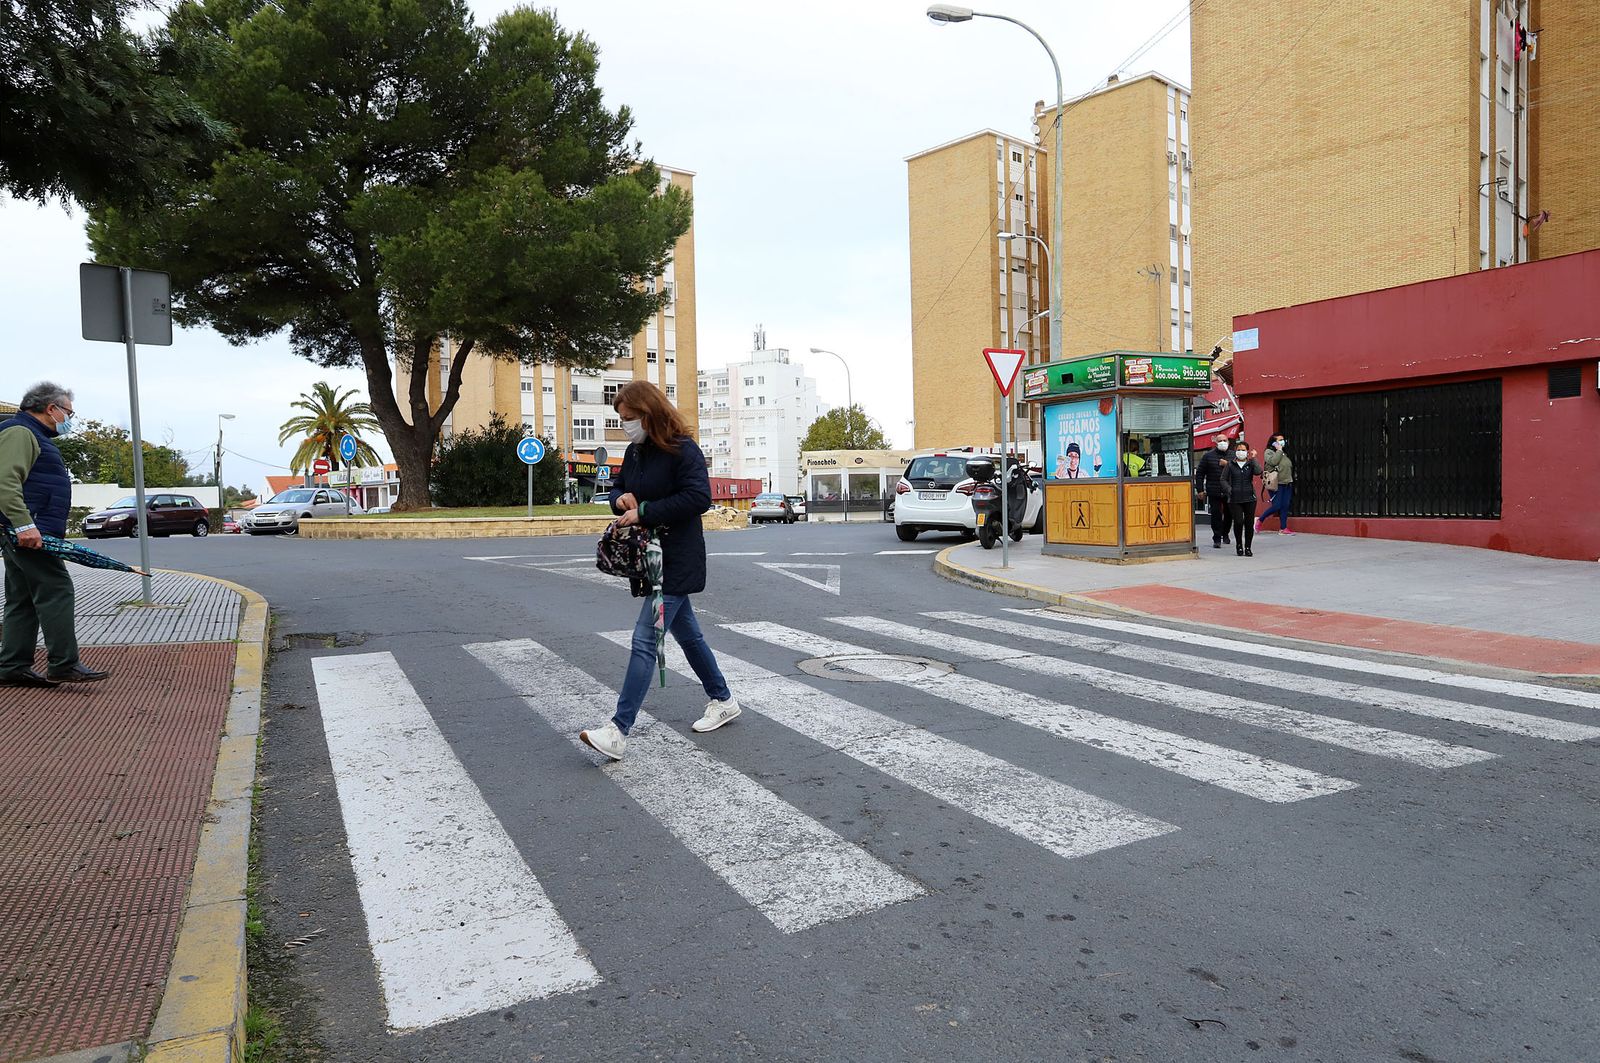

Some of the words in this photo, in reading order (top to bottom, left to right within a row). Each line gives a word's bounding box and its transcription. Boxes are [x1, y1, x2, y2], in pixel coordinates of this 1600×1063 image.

[1154, 364, 1162, 372] 75
[1182, 369, 1208, 377] 910.000
[1058, 417, 1100, 435] JUGAMOS
